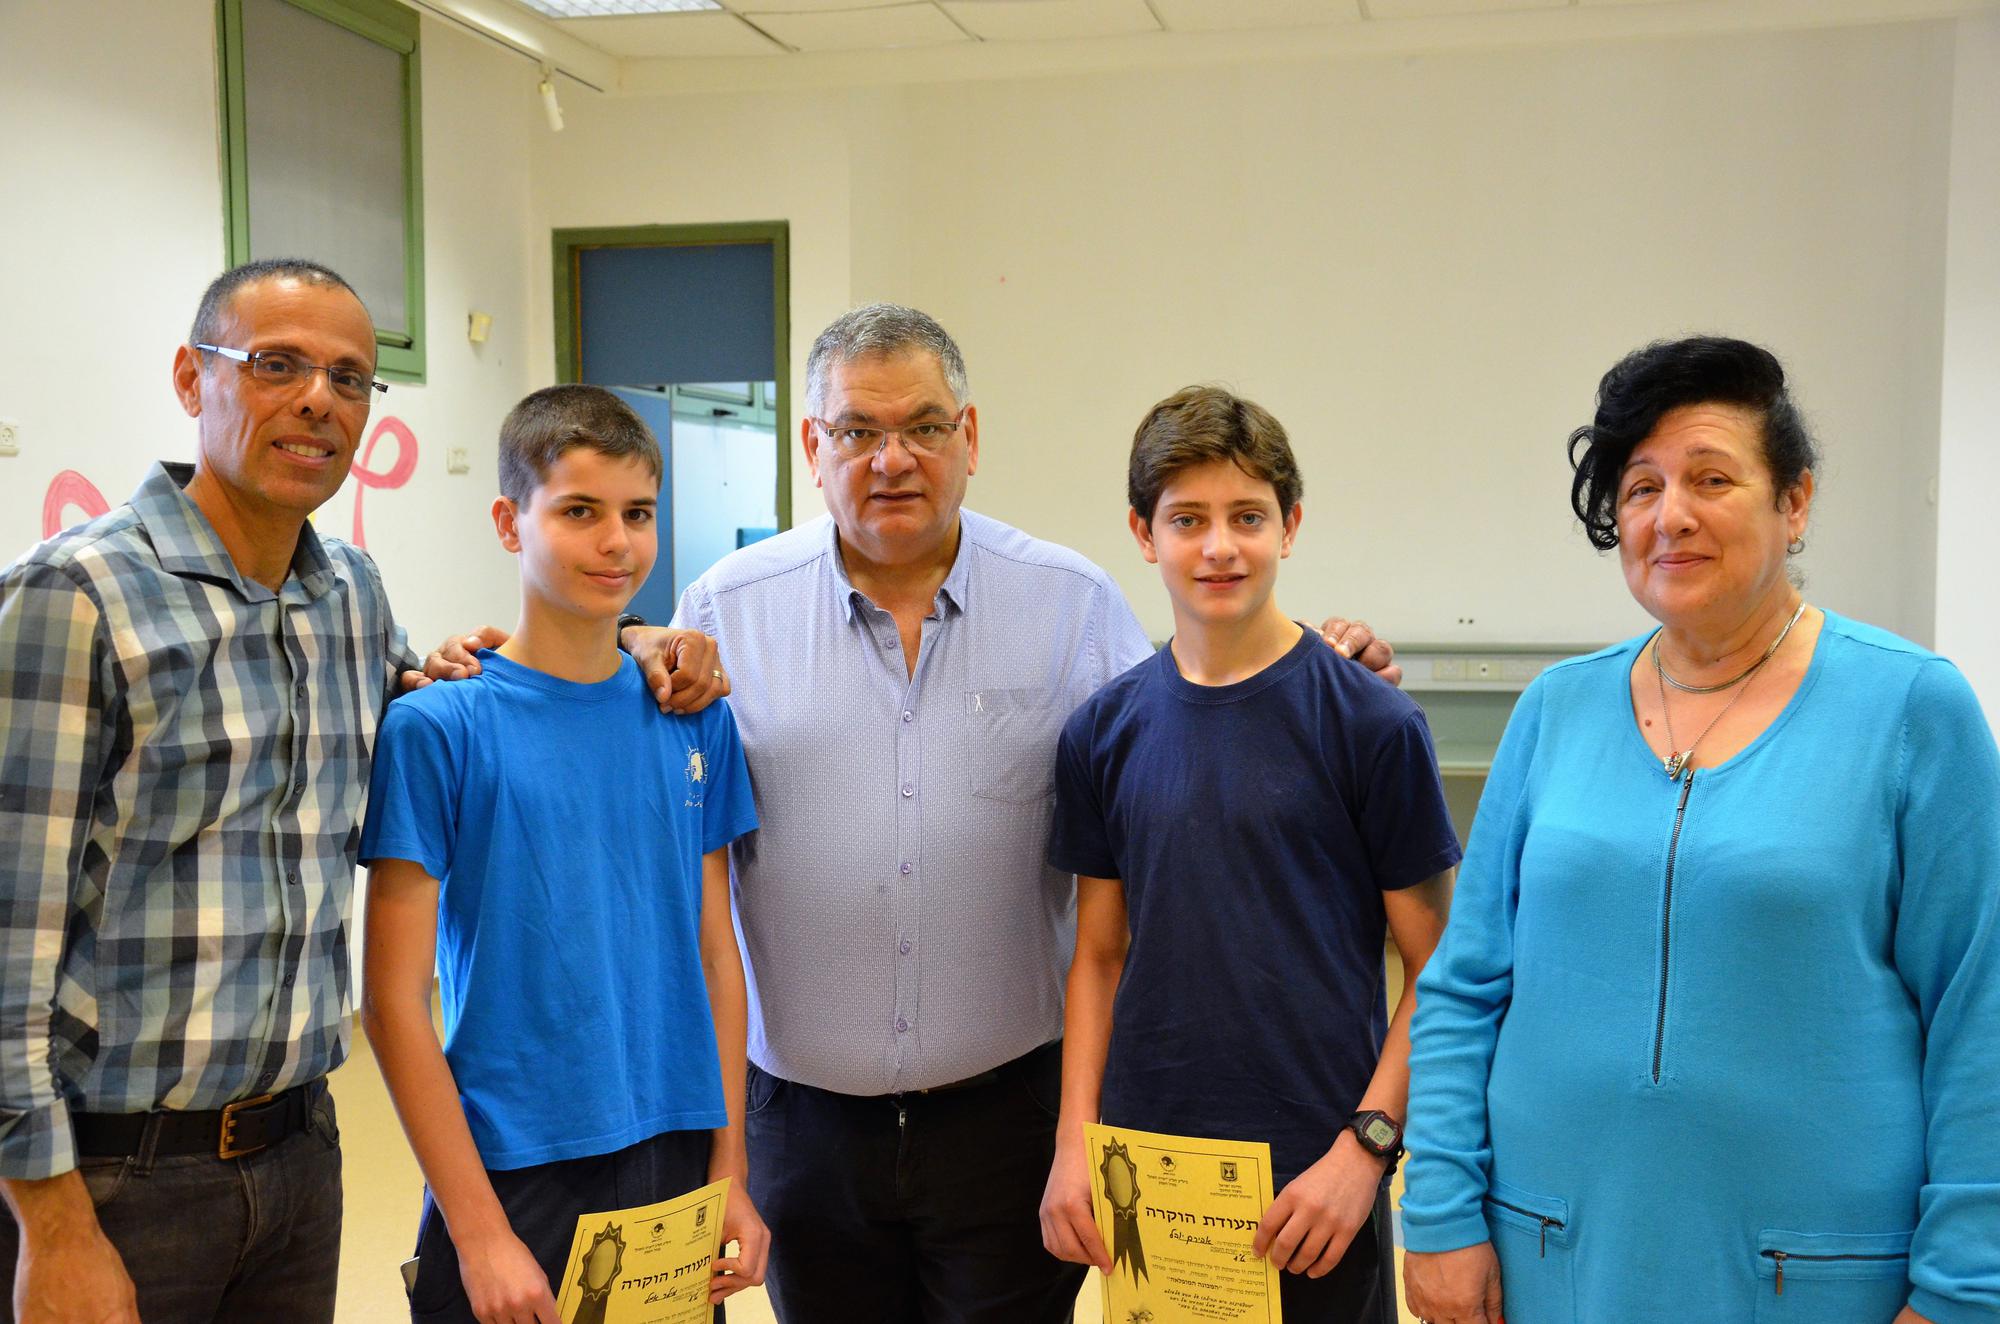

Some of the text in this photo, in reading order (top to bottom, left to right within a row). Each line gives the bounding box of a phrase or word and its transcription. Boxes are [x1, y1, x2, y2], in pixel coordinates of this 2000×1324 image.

[1146, 1206, 1258, 1231] תעודת הוקרה
[673, 1254, 711, 1279] תעודת
[621, 1272, 669, 1291] הוקרה
